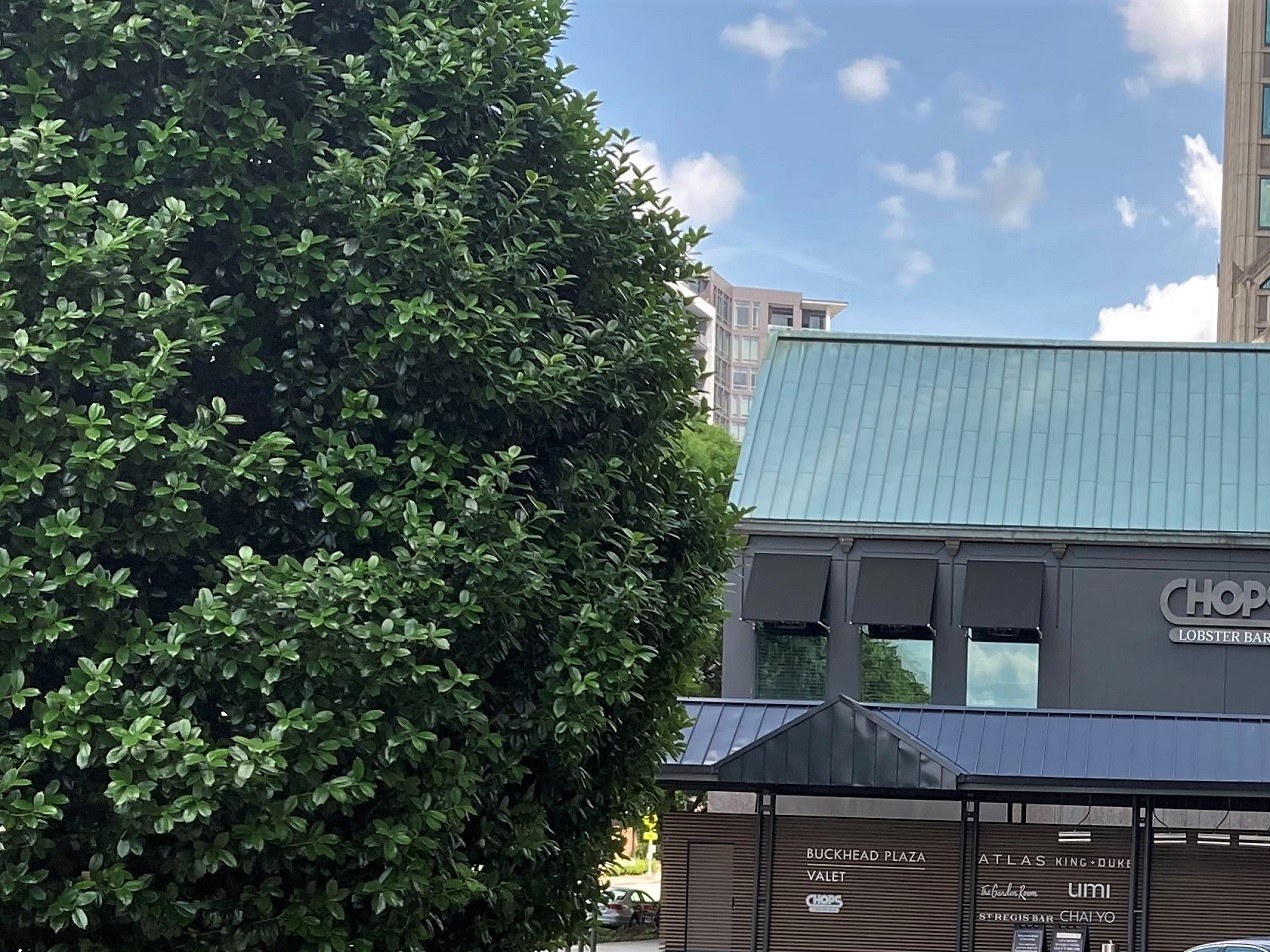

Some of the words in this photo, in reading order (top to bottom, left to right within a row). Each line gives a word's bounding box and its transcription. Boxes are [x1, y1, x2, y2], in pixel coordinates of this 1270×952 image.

[1179, 629, 1241, 643] LOBSTER
[806, 848, 879, 861] BUCKHEAD
[884, 850, 926, 863] PLAZA
[978, 853, 1046, 867] ATLAS
[1055, 857, 1087, 868] KING
[806, 870, 846, 882] VALET
[980, 884, 991, 896] The
[1018, 884, 1039, 900] Room
[805, 893, 844, 908] CHOPS
[994, 913, 1030, 922] REGIS
[1032, 914, 1054, 923] BAR
[1059, 910, 1093, 923] CHAI
[1096, 911, 1116, 924] YO
